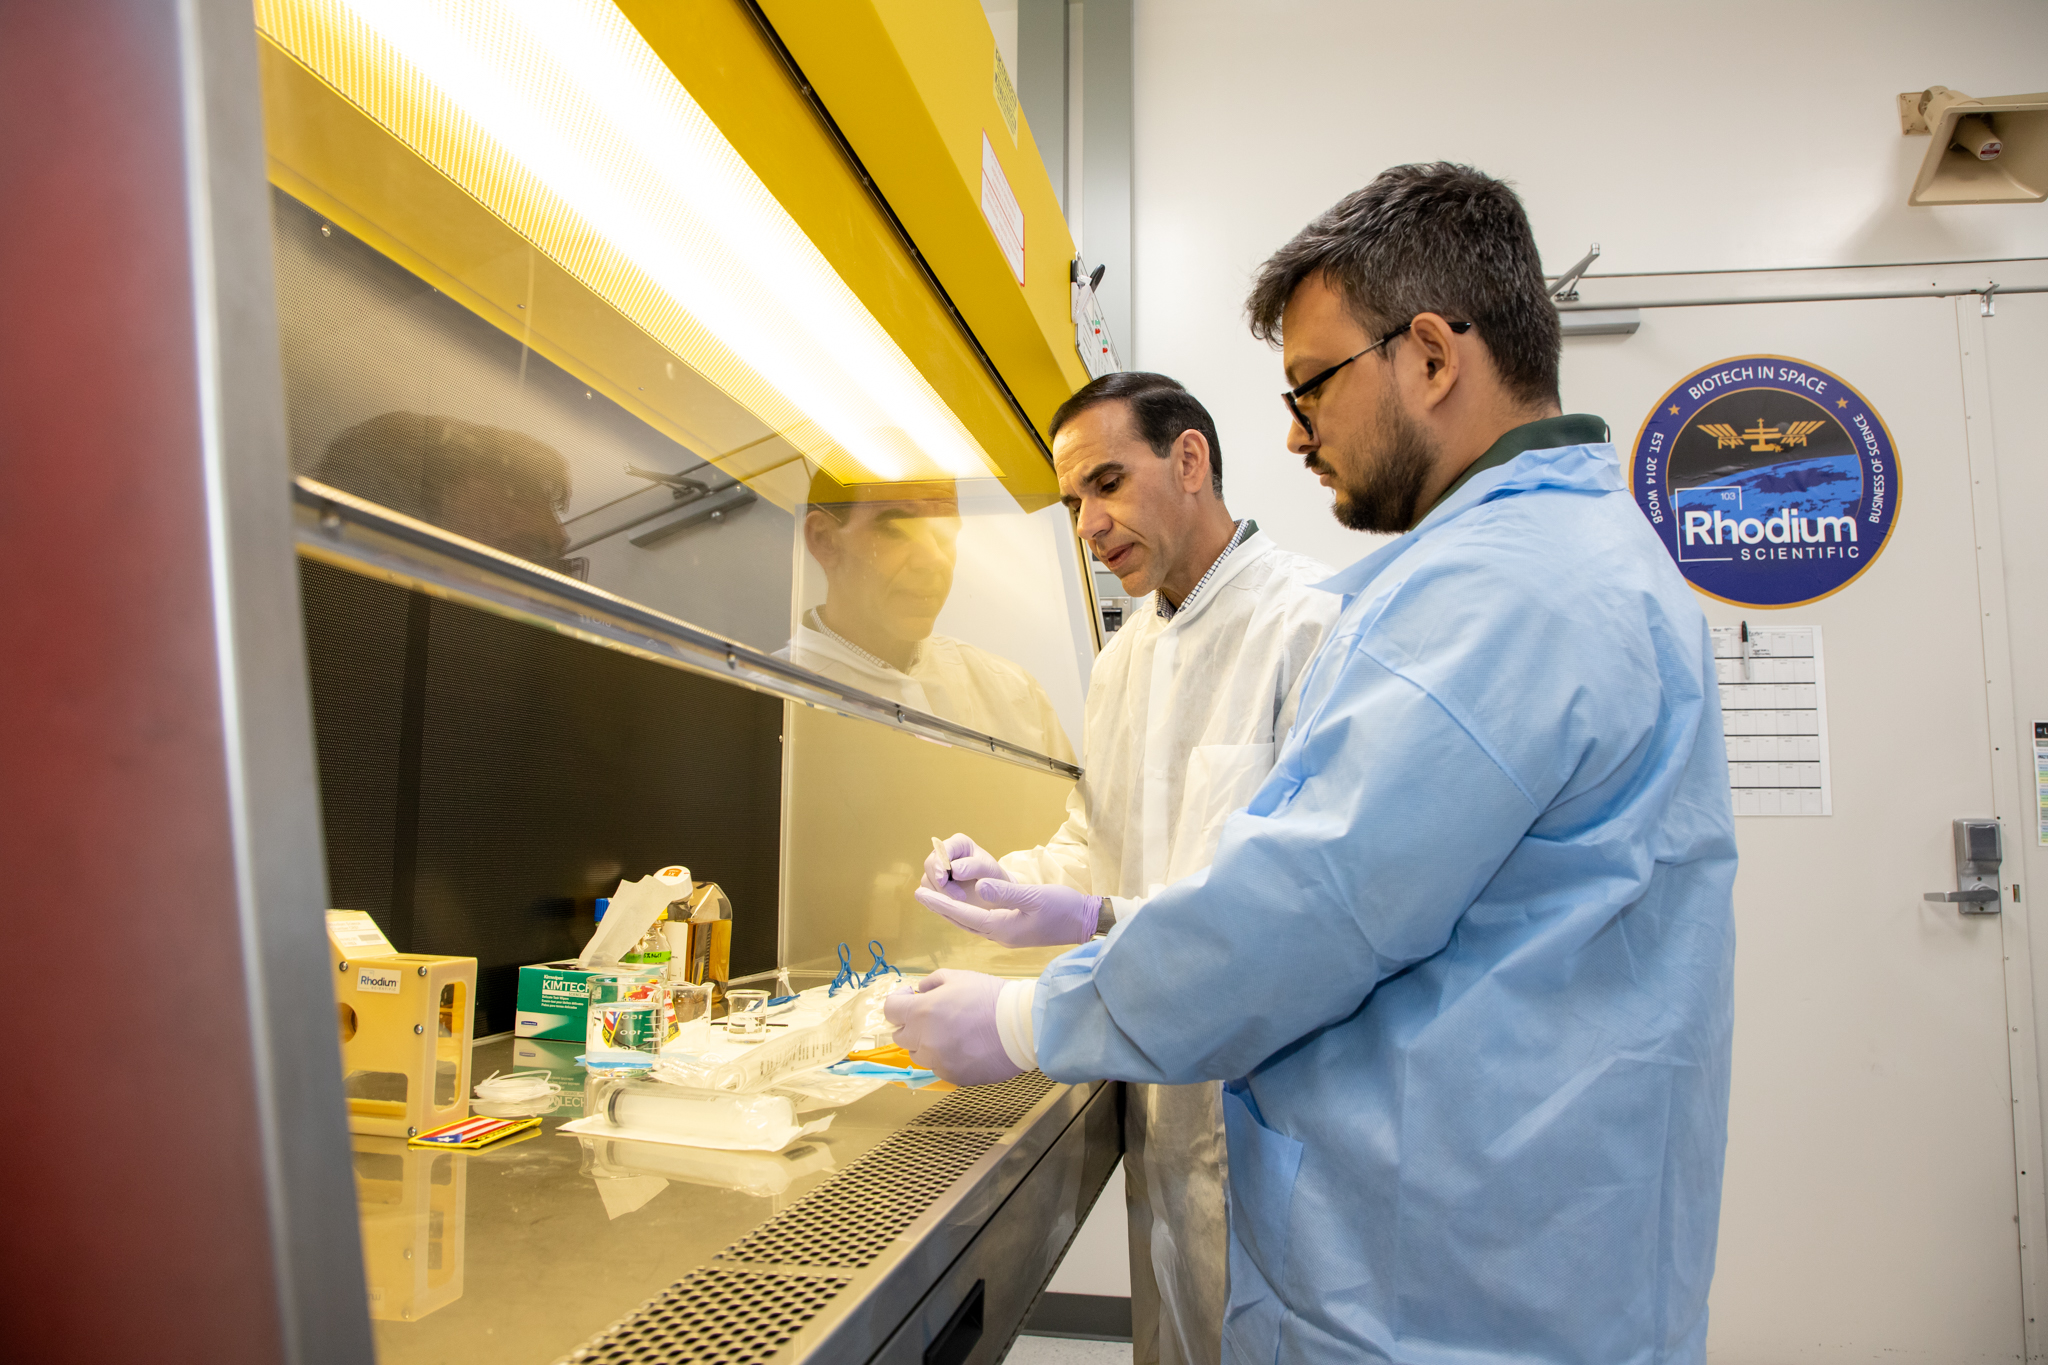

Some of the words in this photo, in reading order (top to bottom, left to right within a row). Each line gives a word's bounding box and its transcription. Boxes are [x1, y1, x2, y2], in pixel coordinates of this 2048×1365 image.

[1687, 367, 1753, 400] BIOTECH
[1757, 365, 1775, 379] IN
[1778, 367, 1828, 395] SPACE
[1648, 431, 1665, 454] EST.
[1852, 413, 1881, 457] SCIENCE
[1646, 456, 1658, 485] 2014
[1870, 458, 1884, 473] OF
[1647, 489, 1664, 525] WOSB
[1720, 492, 1736, 501] 103
[1868, 474, 1885, 524] BUSINESS
[1684, 508, 1858, 546] Rhodium
[1740, 546, 1860, 561] SCIENTIFIC
[360, 975, 397, 987] Rhodium
